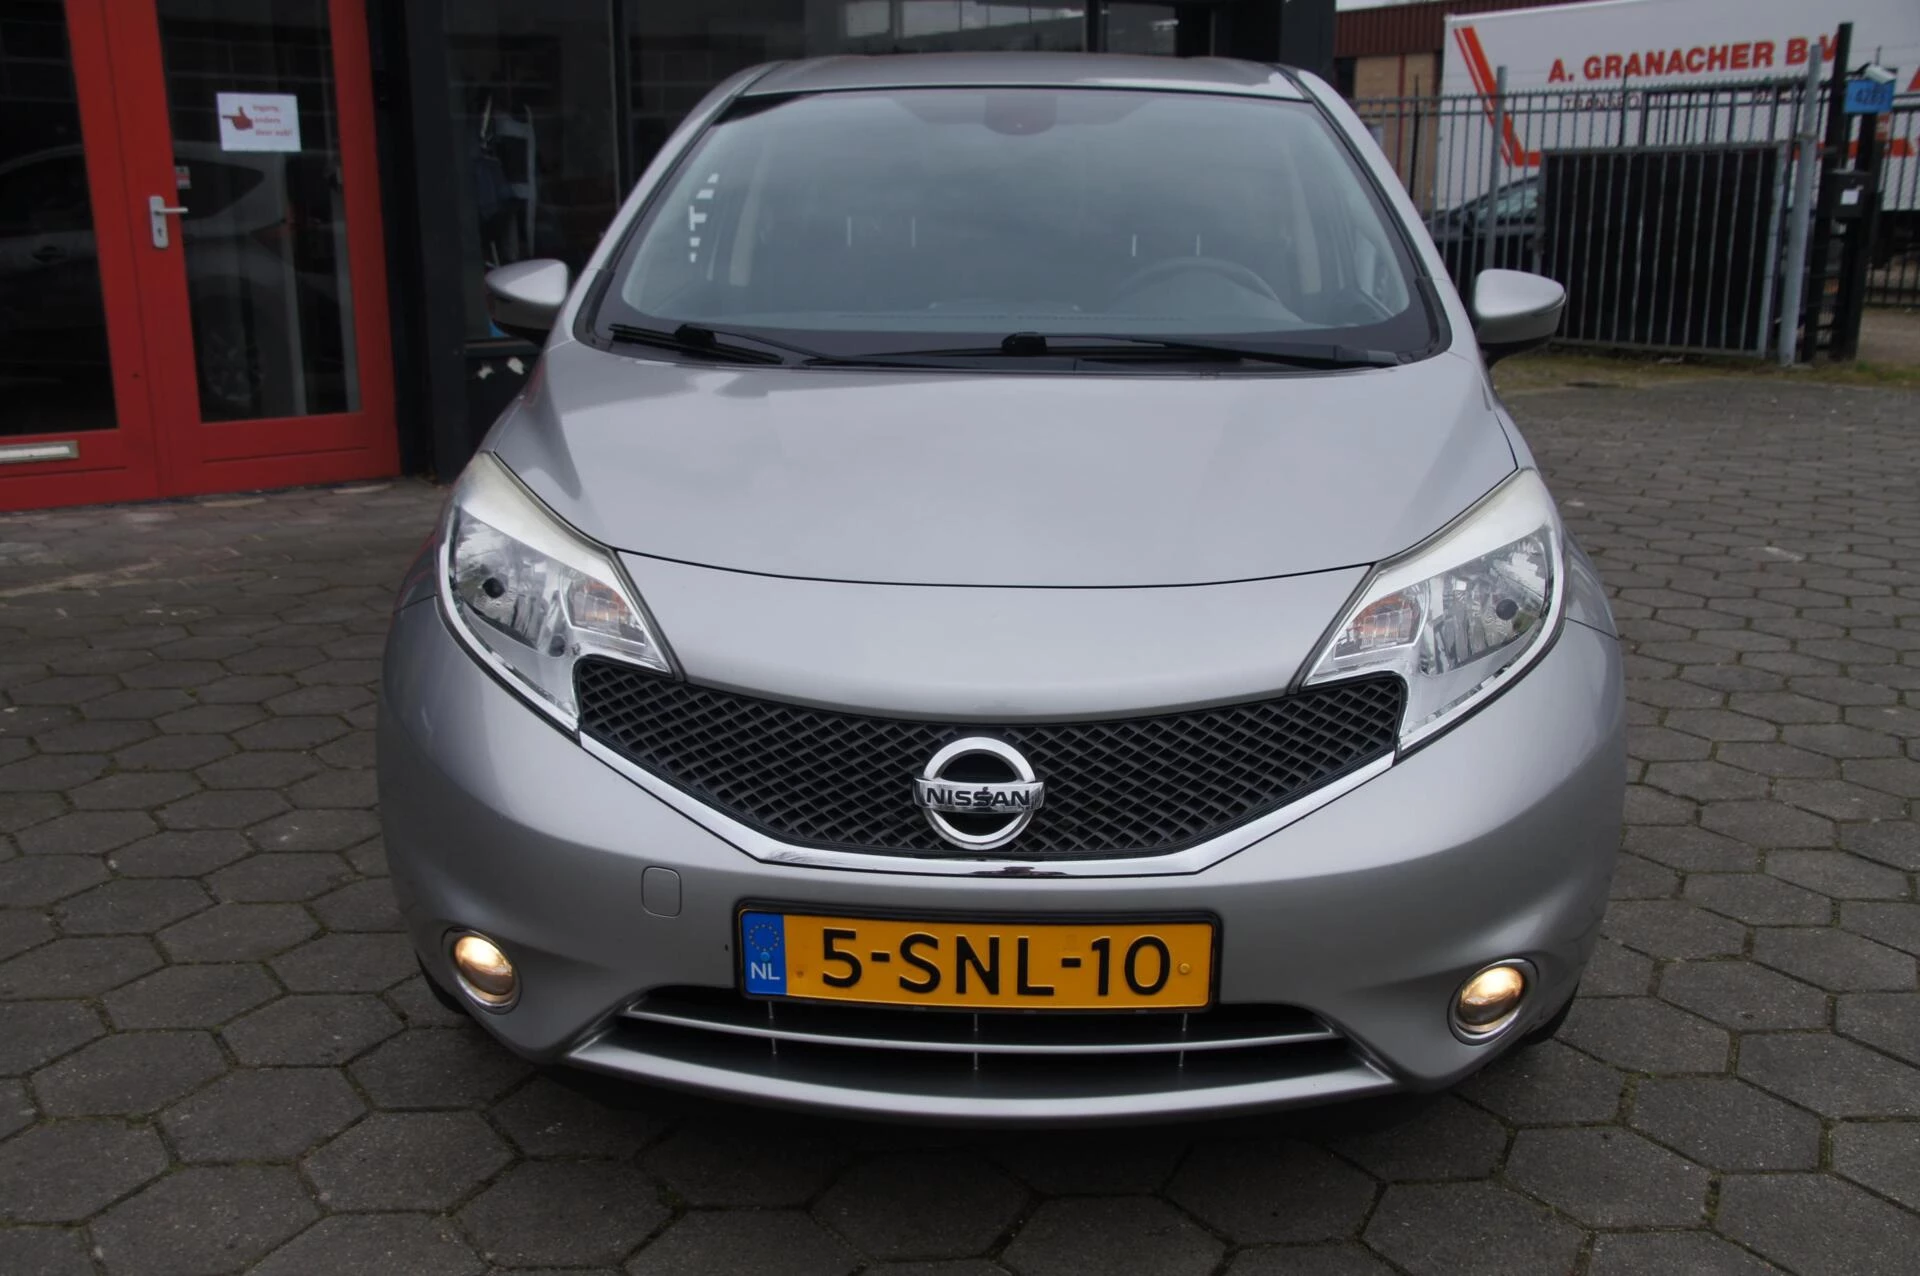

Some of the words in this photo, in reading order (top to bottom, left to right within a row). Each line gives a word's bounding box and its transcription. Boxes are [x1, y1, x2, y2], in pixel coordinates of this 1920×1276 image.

[1548, 58, 1575, 83] A.
[1583, 40, 1775, 81] GRANACHER
[926, 787, 1030, 806] NISSAN
[750, 962, 781, 980] NL
[821, 927, 1171, 997] 5-SNL-10
